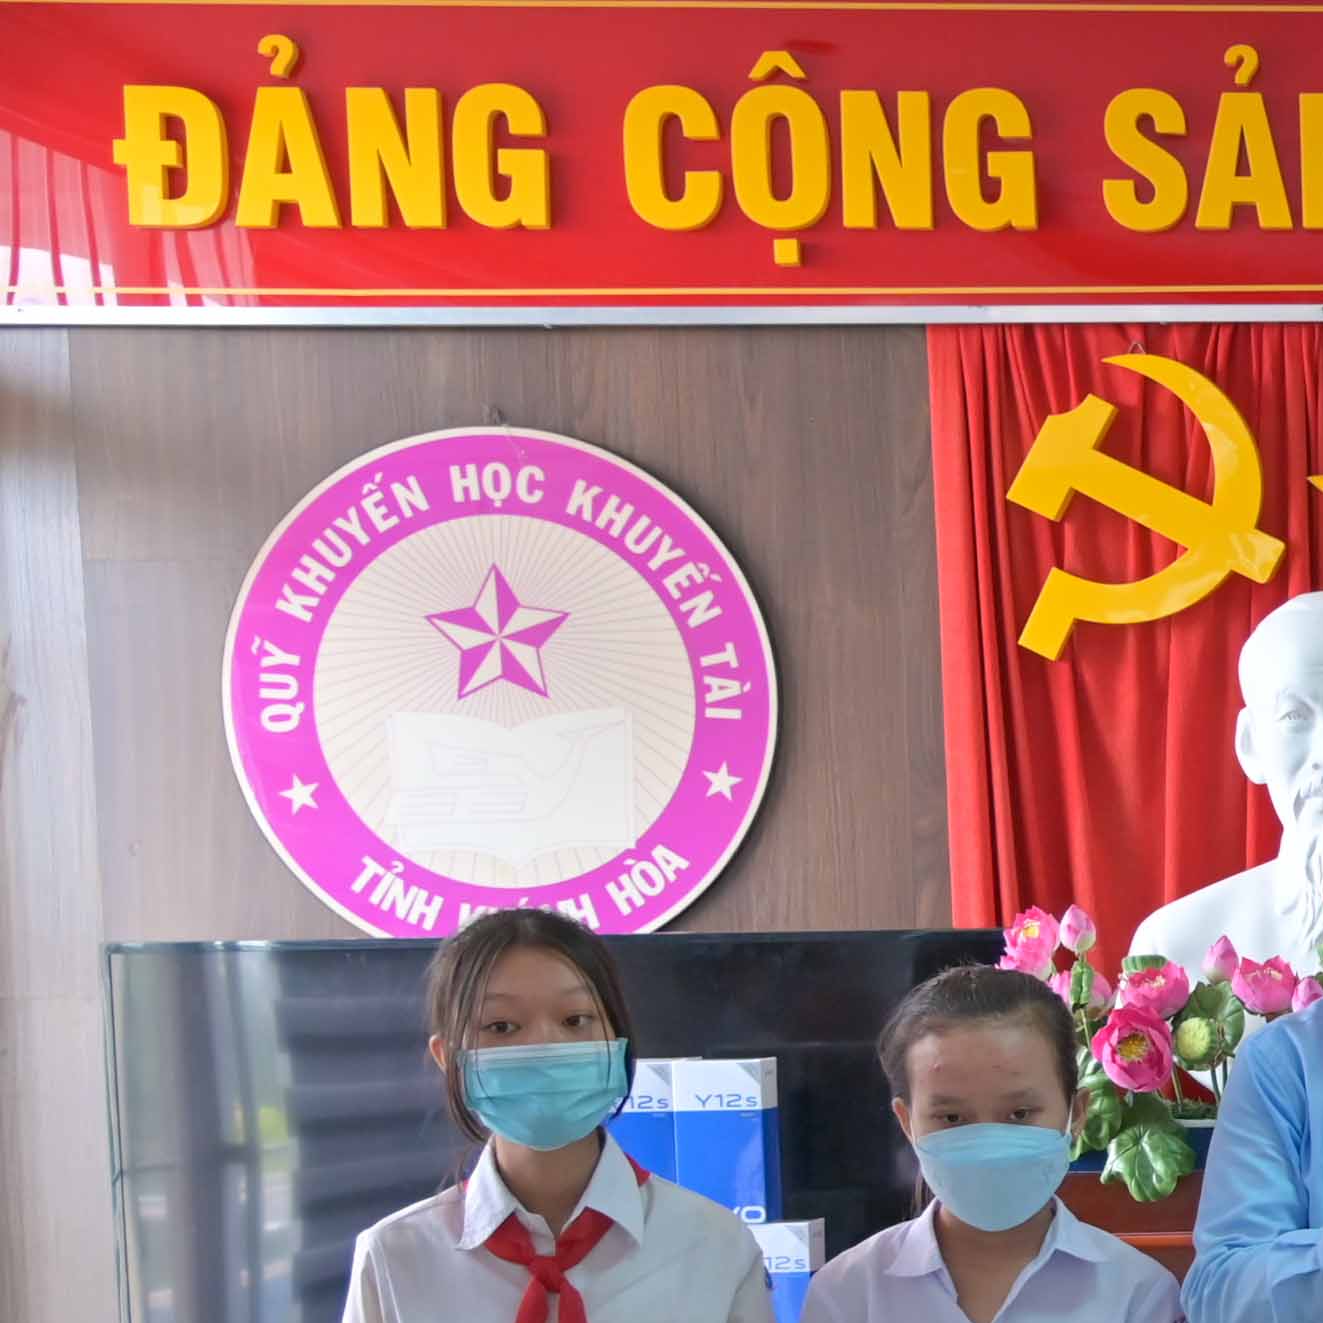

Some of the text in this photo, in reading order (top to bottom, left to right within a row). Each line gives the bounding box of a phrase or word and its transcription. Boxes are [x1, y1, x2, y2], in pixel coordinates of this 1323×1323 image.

[112, 34, 551, 230] ĐẢNG
[622, 50, 1037, 266] CỘNG
[252, 462, 754, 733] QUỸ KHUYẾN HỌC KHUYẾN TÀI
[349, 856, 443, 931] TỈNH
[605, 844, 690, 917] HÒA
[620, 1095, 669, 1109] 12s
[695, 1093, 759, 1109] Y12s
[765, 1256, 807, 1270] 12s
